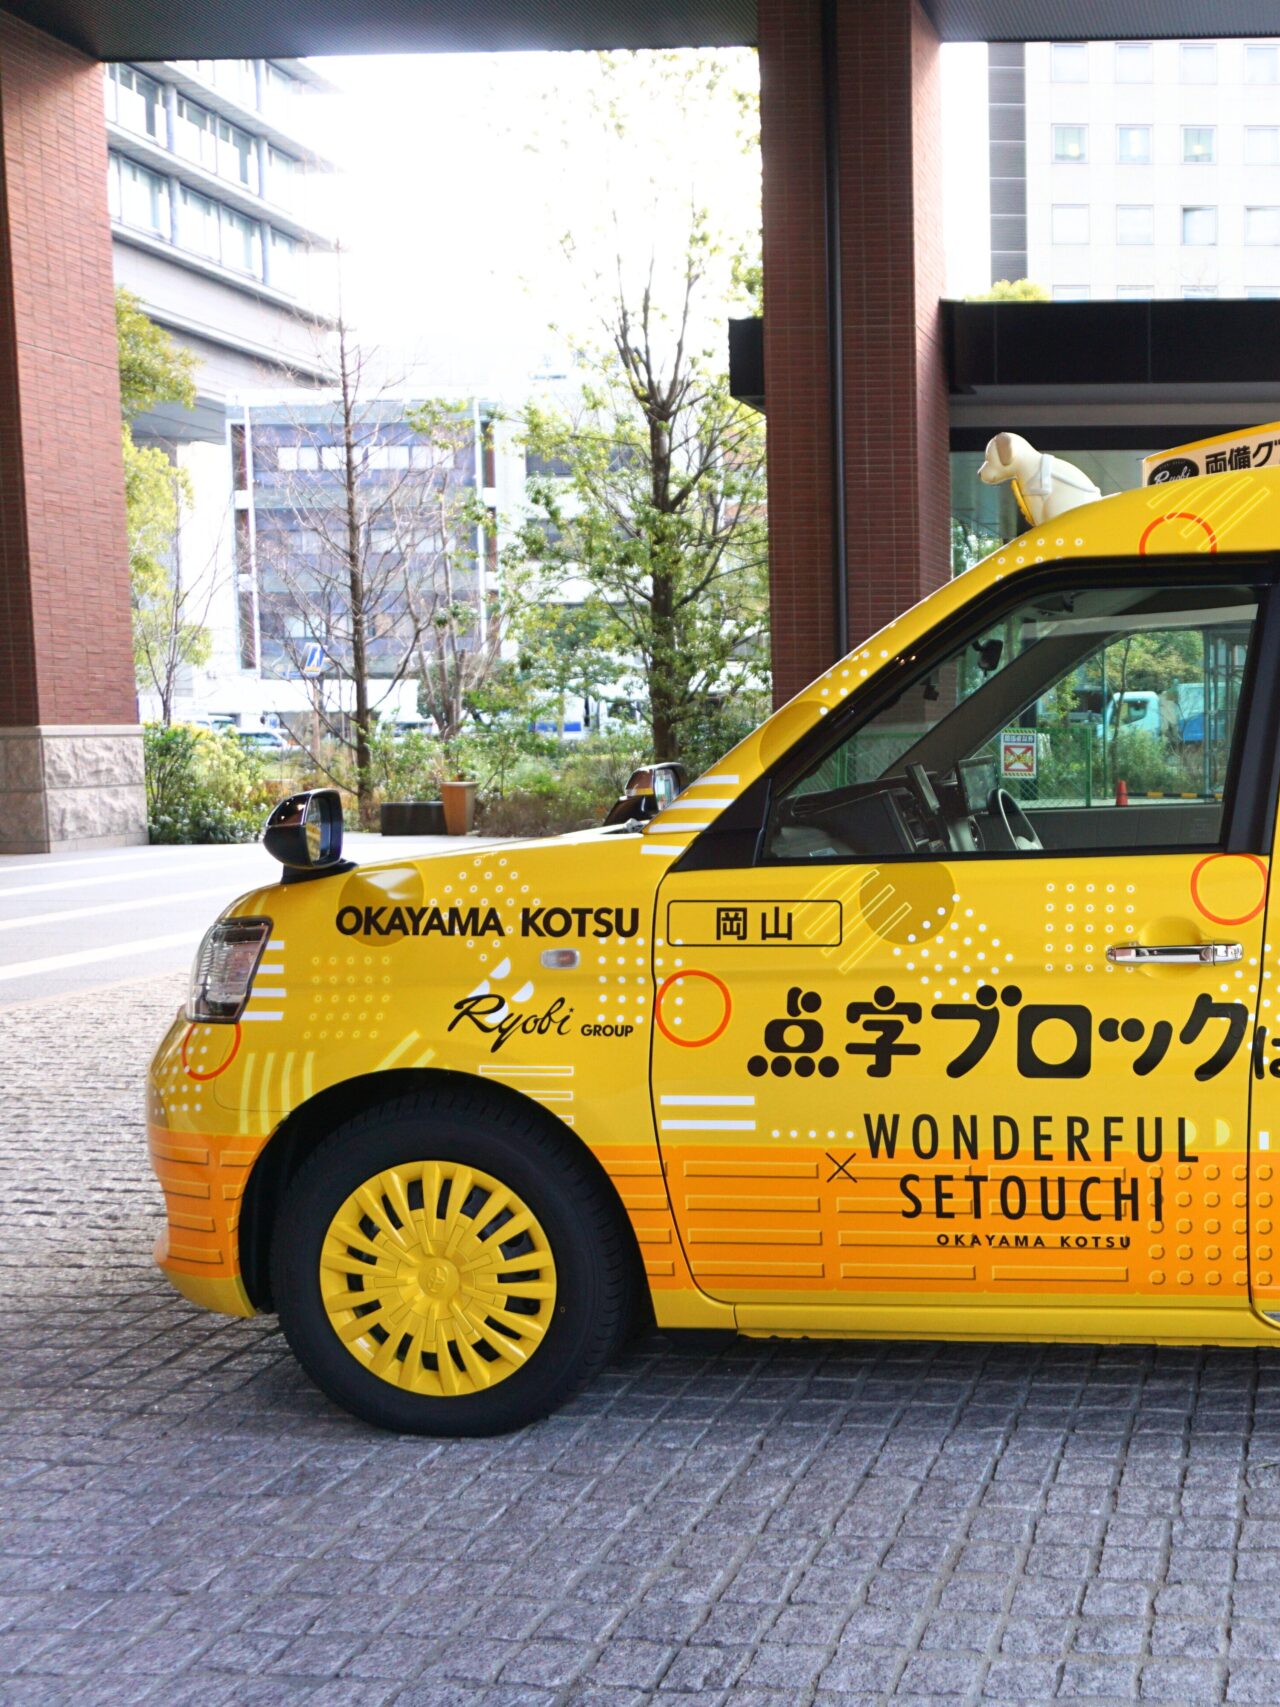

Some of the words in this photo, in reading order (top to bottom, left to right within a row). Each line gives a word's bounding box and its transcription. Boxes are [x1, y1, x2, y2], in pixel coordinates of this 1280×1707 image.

[335, 905, 506, 937] OKAYAMA
[520, 906, 640, 938] KOTSU
[715, 906, 794, 942] 岡山
[446, 993, 575, 1053] Ryobi
[581, 1024, 635, 1037] GROUP
[863, 1112, 1200, 1164] WONDERFUL
[899, 1173, 1164, 1223] SETOUCHI
[936, 1233, 1047, 1248] OKAYAMA
[1059, 1235, 1133, 1250] KOTSU
